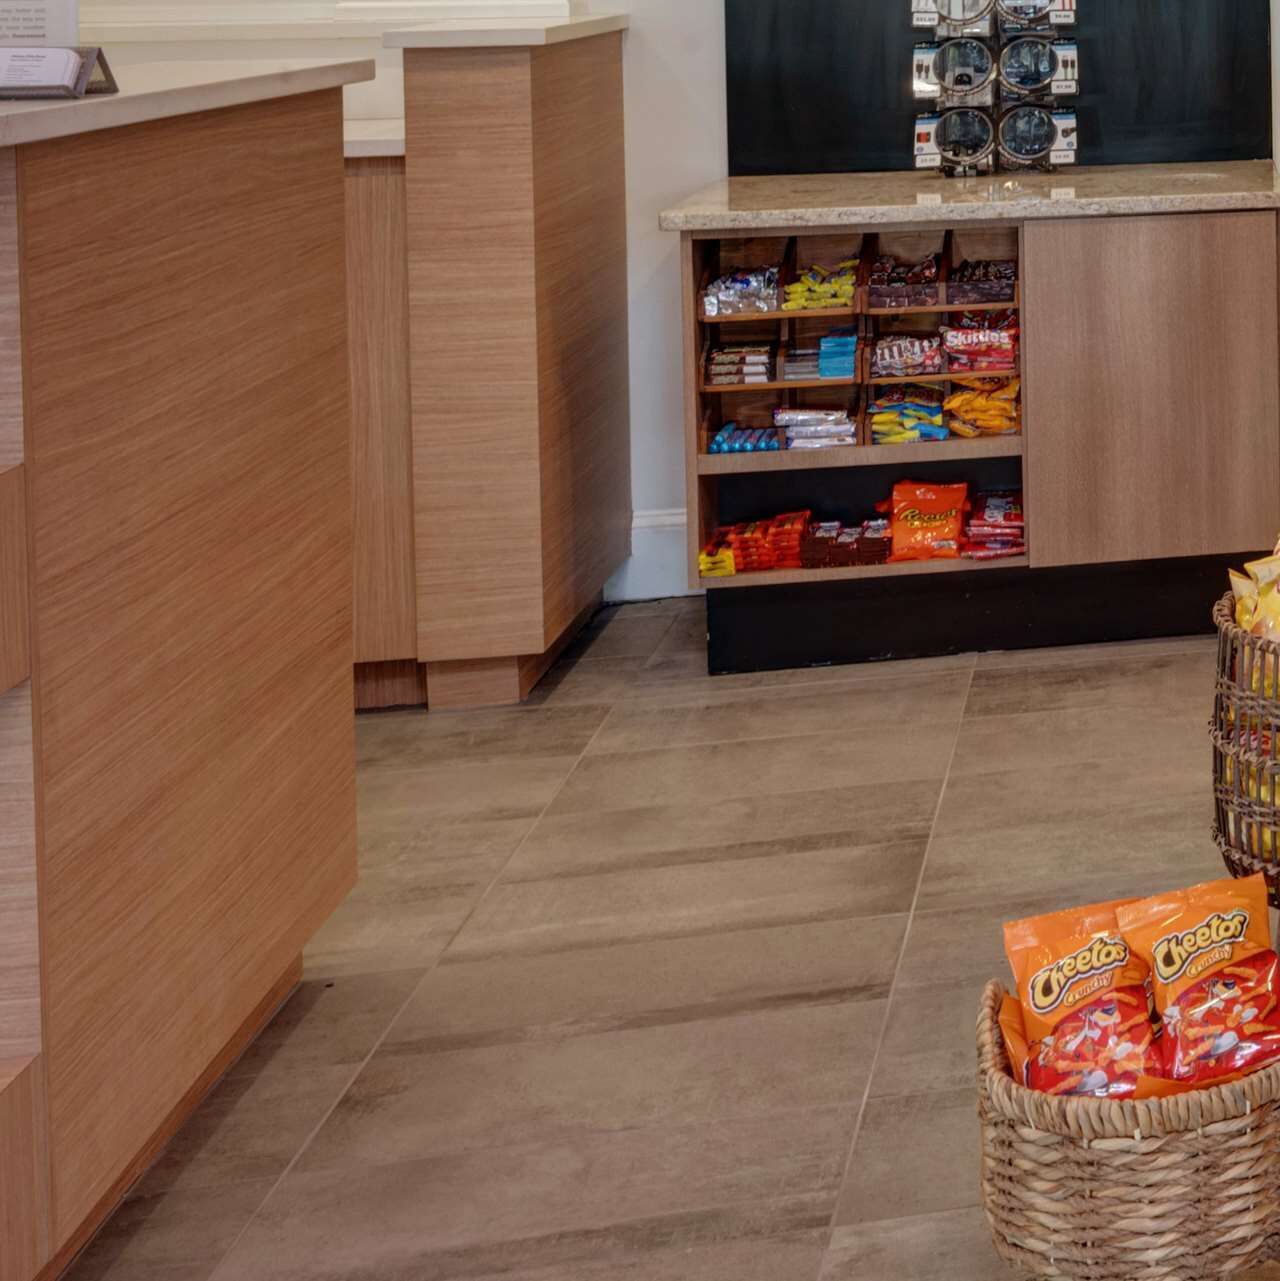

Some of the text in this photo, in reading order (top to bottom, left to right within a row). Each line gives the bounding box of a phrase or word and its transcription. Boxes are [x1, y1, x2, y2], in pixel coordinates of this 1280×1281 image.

[944, 328, 1010, 347] Skittles
[1151, 910, 1249, 983] Cheetos
[1186, 944, 1233, 979] Crunchy
[1029, 936, 1130, 1013] Cheetos
[1063, 971, 1114, 1008] Crunchy
